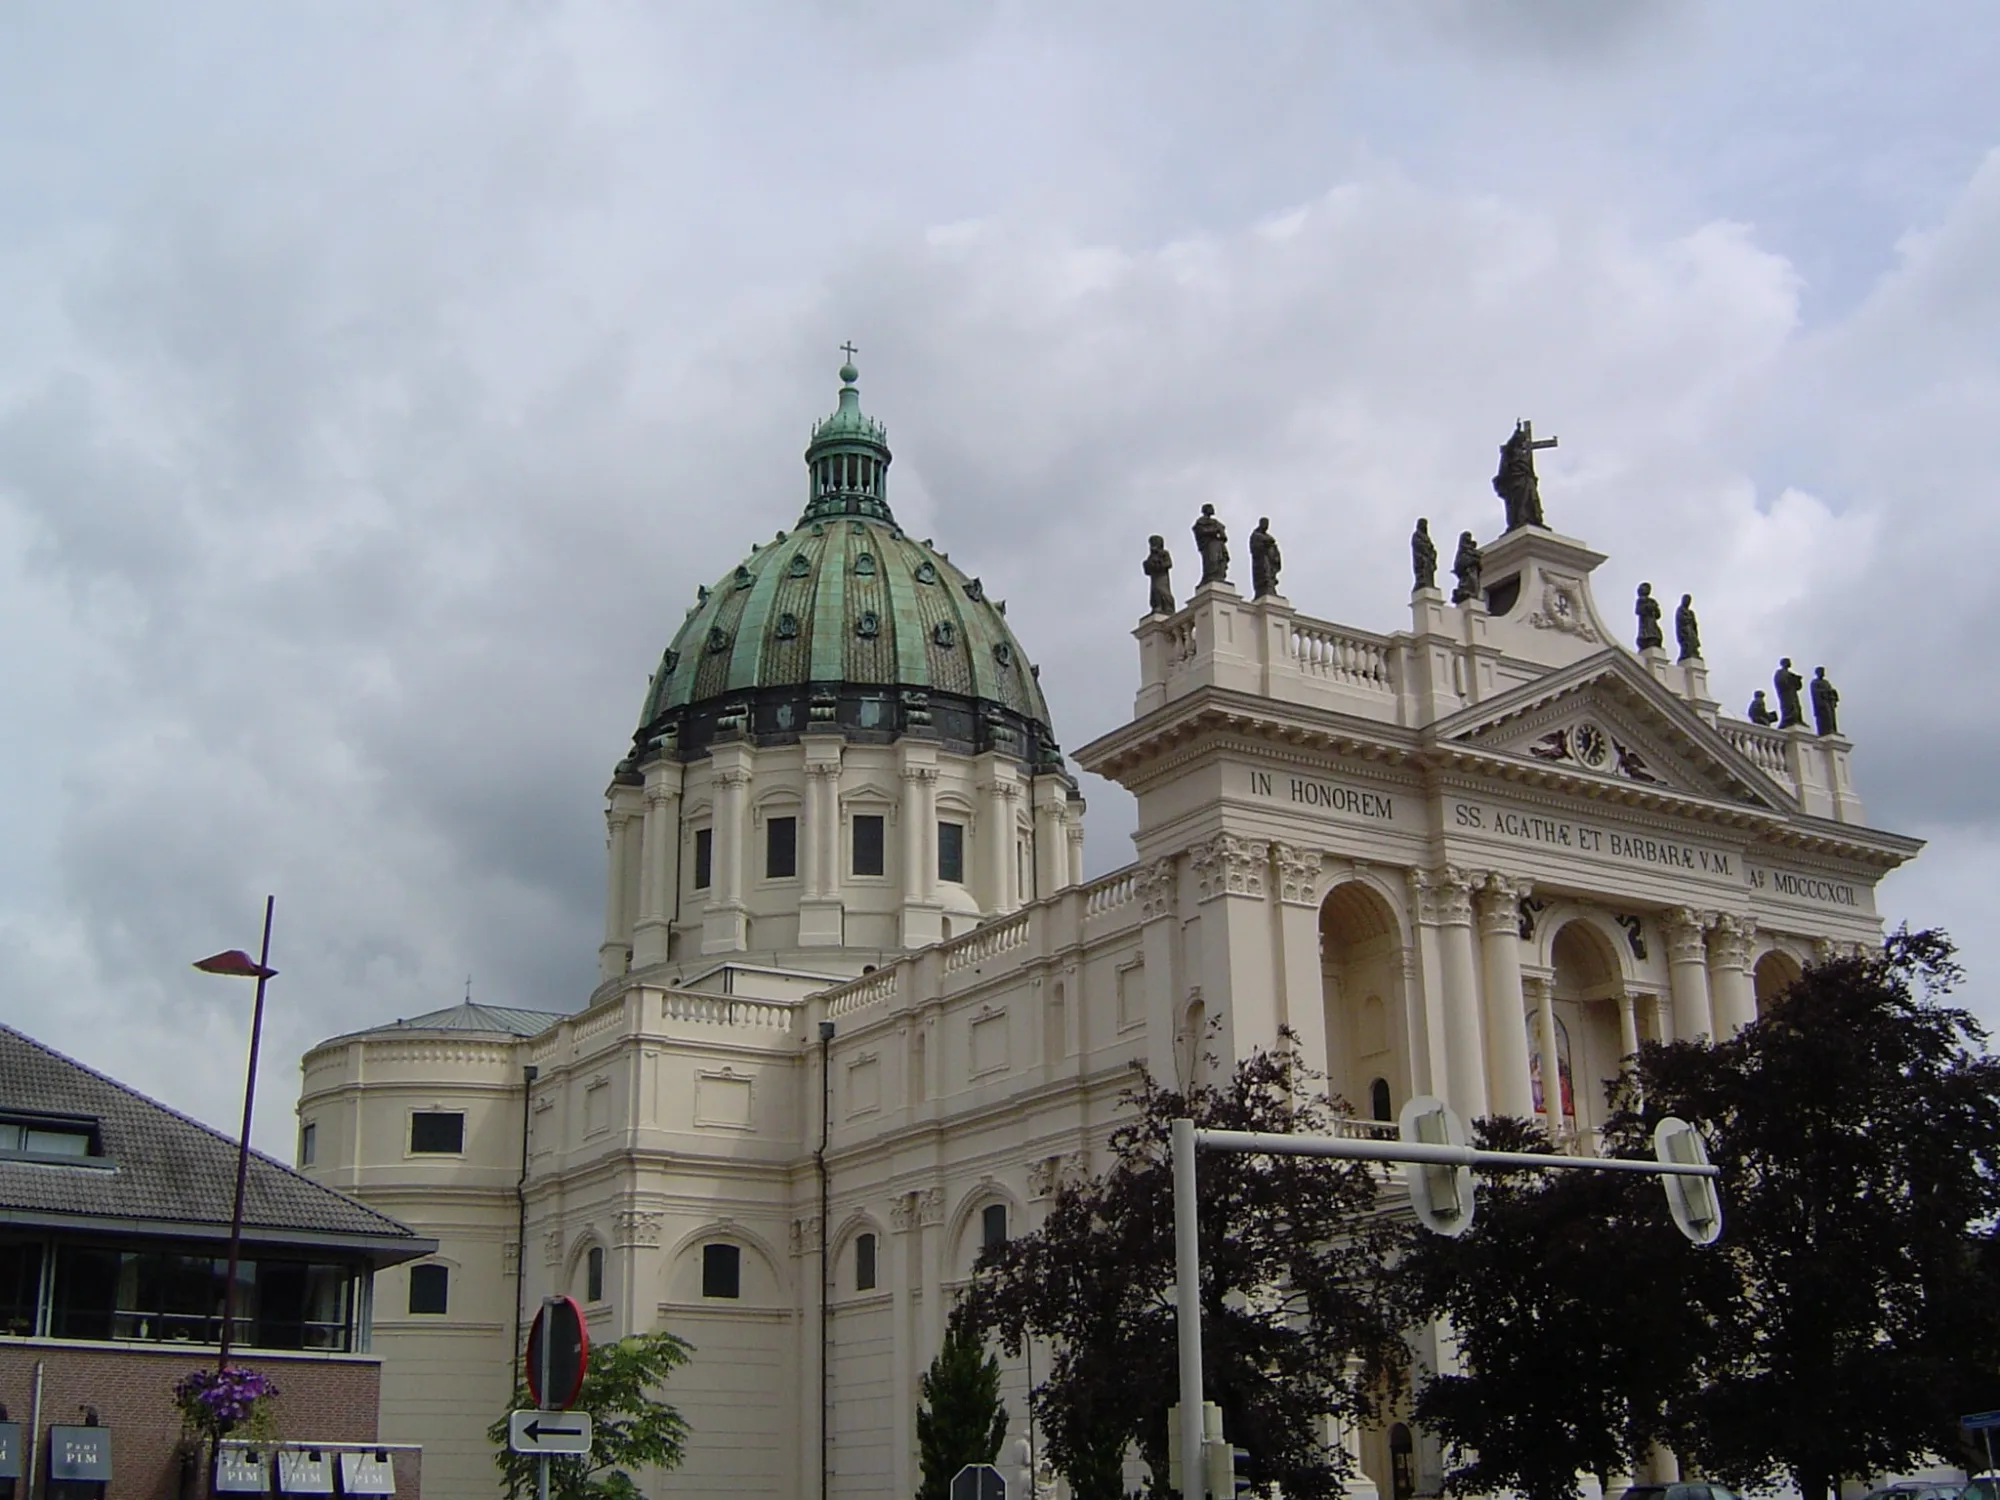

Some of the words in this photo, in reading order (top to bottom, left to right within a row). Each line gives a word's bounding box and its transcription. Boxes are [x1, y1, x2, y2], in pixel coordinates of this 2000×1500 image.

[1250, 771, 1272, 797] IN
[1290, 778, 1393, 820] HONOREM
[1455, 804, 1487, 829] SS.
[1578, 827, 1602, 851] ET
[65, 1452, 98, 1464] PIM
[227, 1471, 258, 1482] PIM
[291, 1472, 321, 1484] PIM
[354, 1474, 383, 1485] PIM
